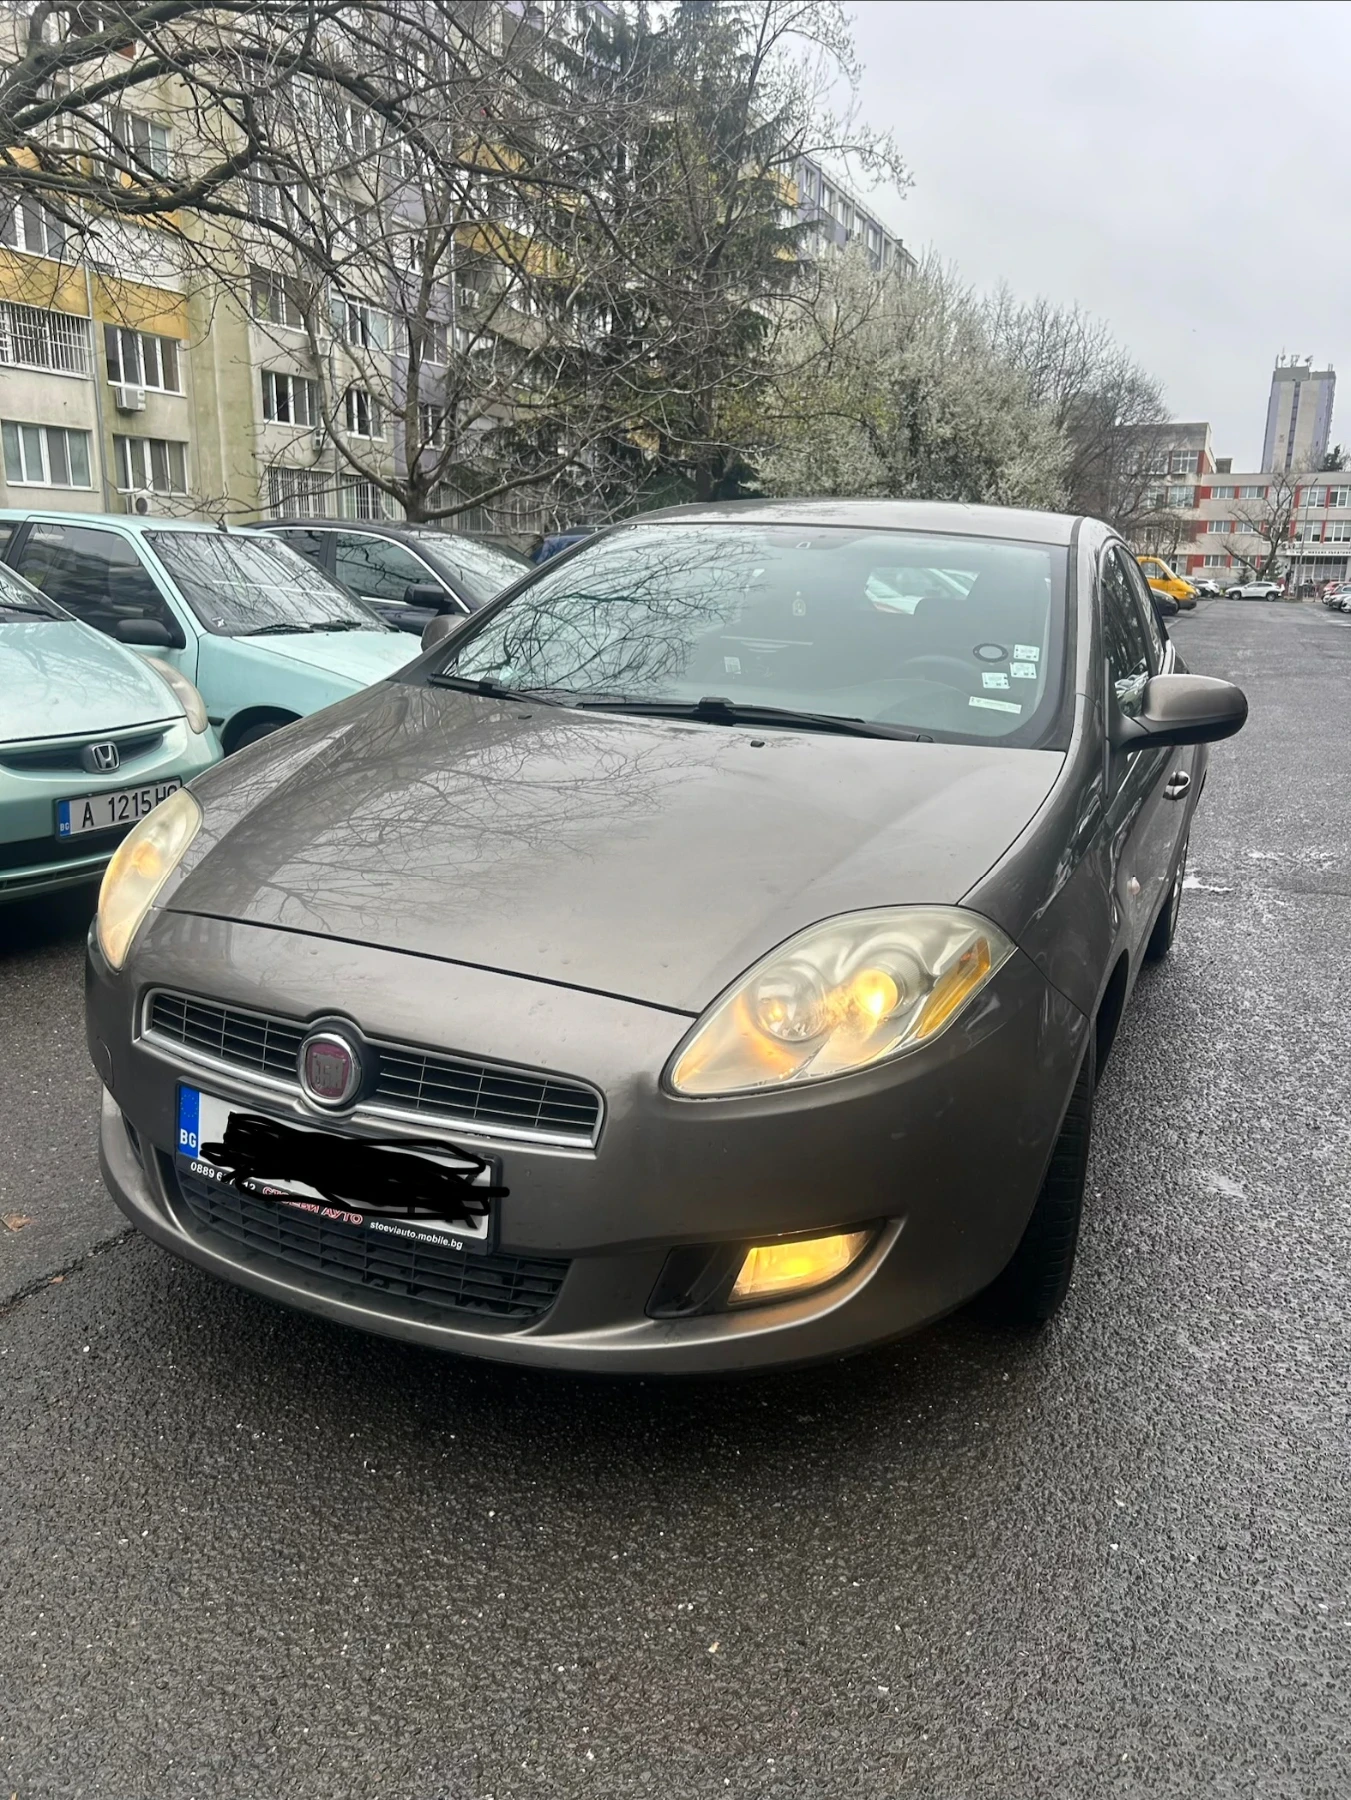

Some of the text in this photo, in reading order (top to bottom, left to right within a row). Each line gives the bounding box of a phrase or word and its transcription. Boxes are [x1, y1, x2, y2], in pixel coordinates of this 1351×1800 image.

[82, 801, 95, 828] A
[59, 822, 70, 832] BG
[180, 1127, 197, 1149] BG
[190, 1161, 215, 1178] 0889
[369, 1221, 463, 1251] stoeviauto.mobile.bg
